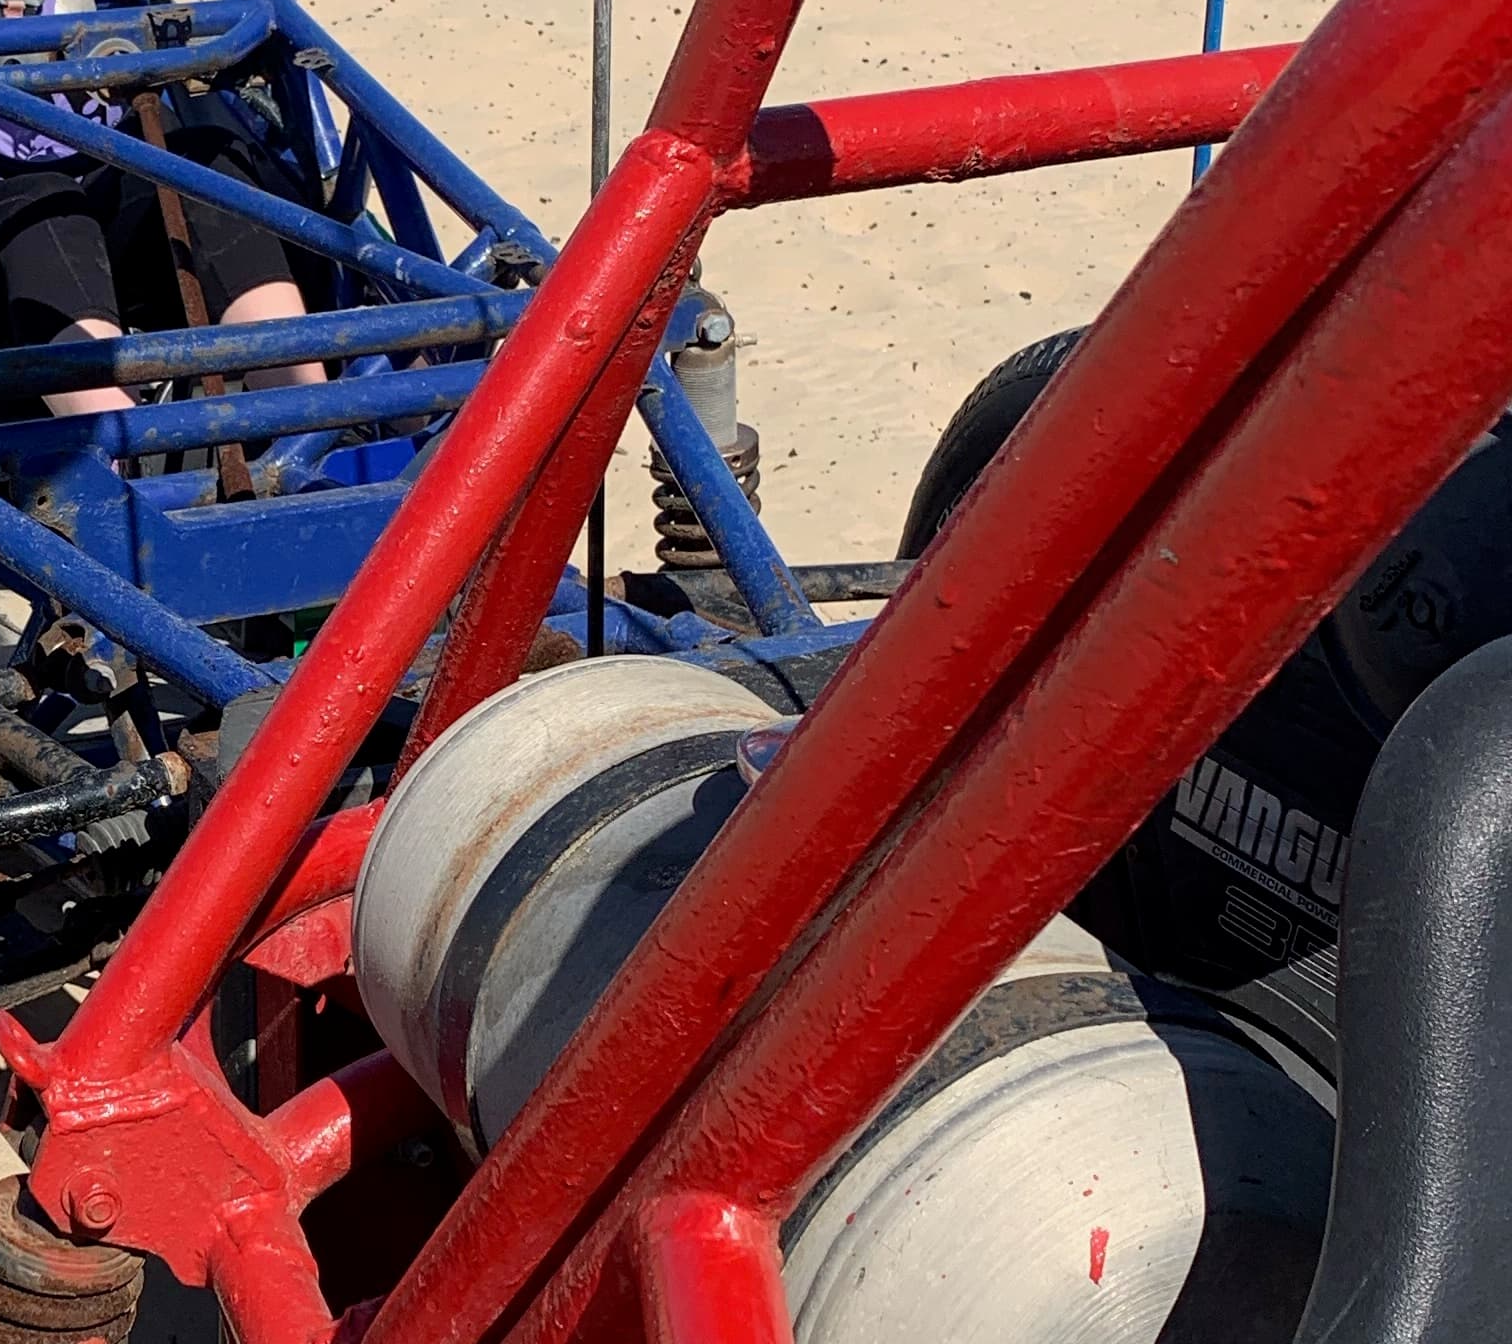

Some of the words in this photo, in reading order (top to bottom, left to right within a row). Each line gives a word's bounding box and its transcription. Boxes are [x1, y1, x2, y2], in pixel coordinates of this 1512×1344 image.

[1175, 756, 1350, 905] VANGU
[1211, 845, 1293, 902] COMMERCIAL
[1297, 892, 1338, 928] POWE
